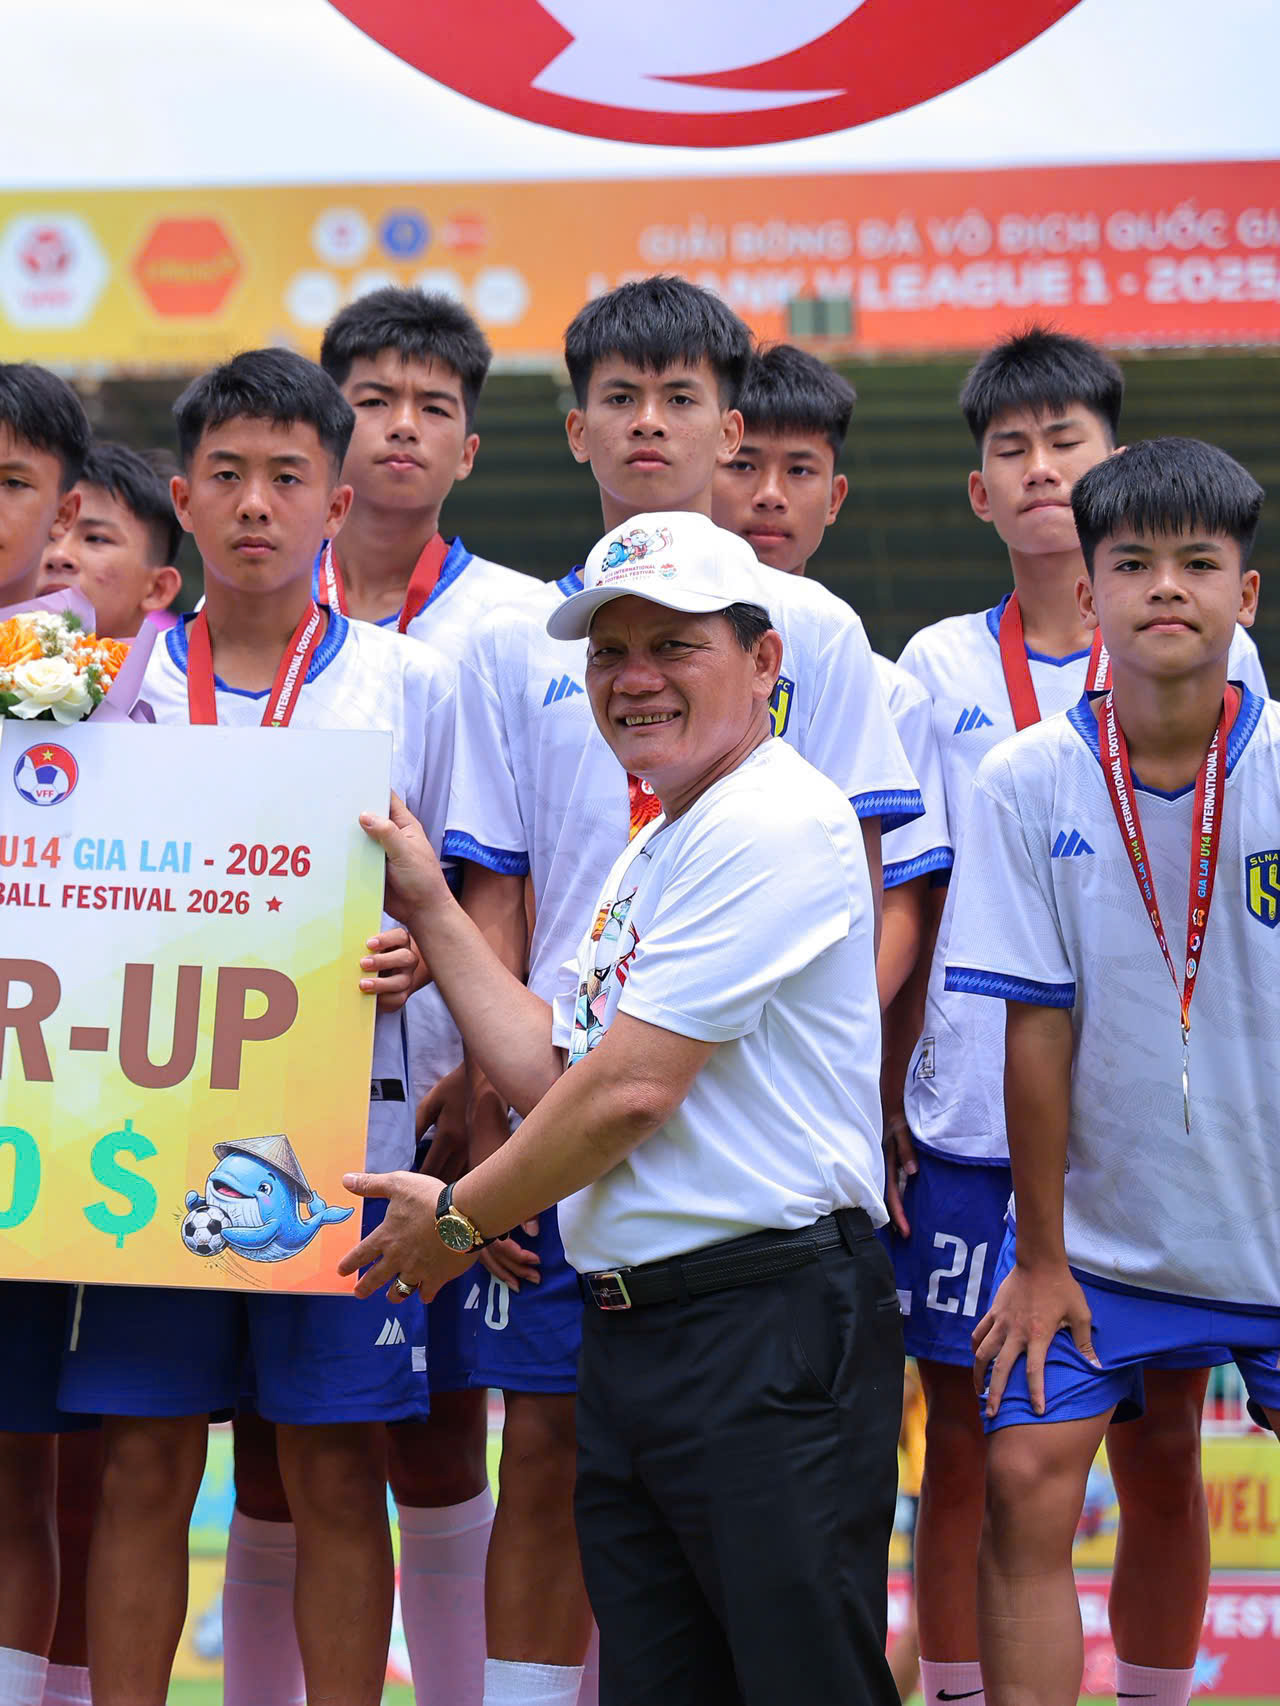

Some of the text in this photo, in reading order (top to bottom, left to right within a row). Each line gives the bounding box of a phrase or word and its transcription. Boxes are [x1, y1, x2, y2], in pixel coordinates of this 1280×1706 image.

[1078, 258, 1113, 306] 1
[273, 653, 305, 721] INTERNATIONAL
[777, 679, 792, 691] FC
[1107, 708, 1120, 758] FOOTBALL
[36, 790, 54, 798] VFF
[1111, 758, 1137, 840] INTERNATIONAL
[1201, 750, 1218, 834] INTERNATIONAL
[73, 837, 127, 872] GIA
[140, 840, 192, 874] LAI
[226, 843, 312, 878] 2026
[1131, 840, 1142, 861] U14
[1200, 836, 1211, 857] U14
[1249, 853, 1279, 866] SLNA
[1199, 859, 1210, 877] LAI
[62, 884, 177, 913] FESTIVAL
[187, 889, 251, 916] 2026
[1198, 880, 1207, 898] GIA
[83, 1118, 158, 1248] $
[926, 1231, 988, 1317] 21
